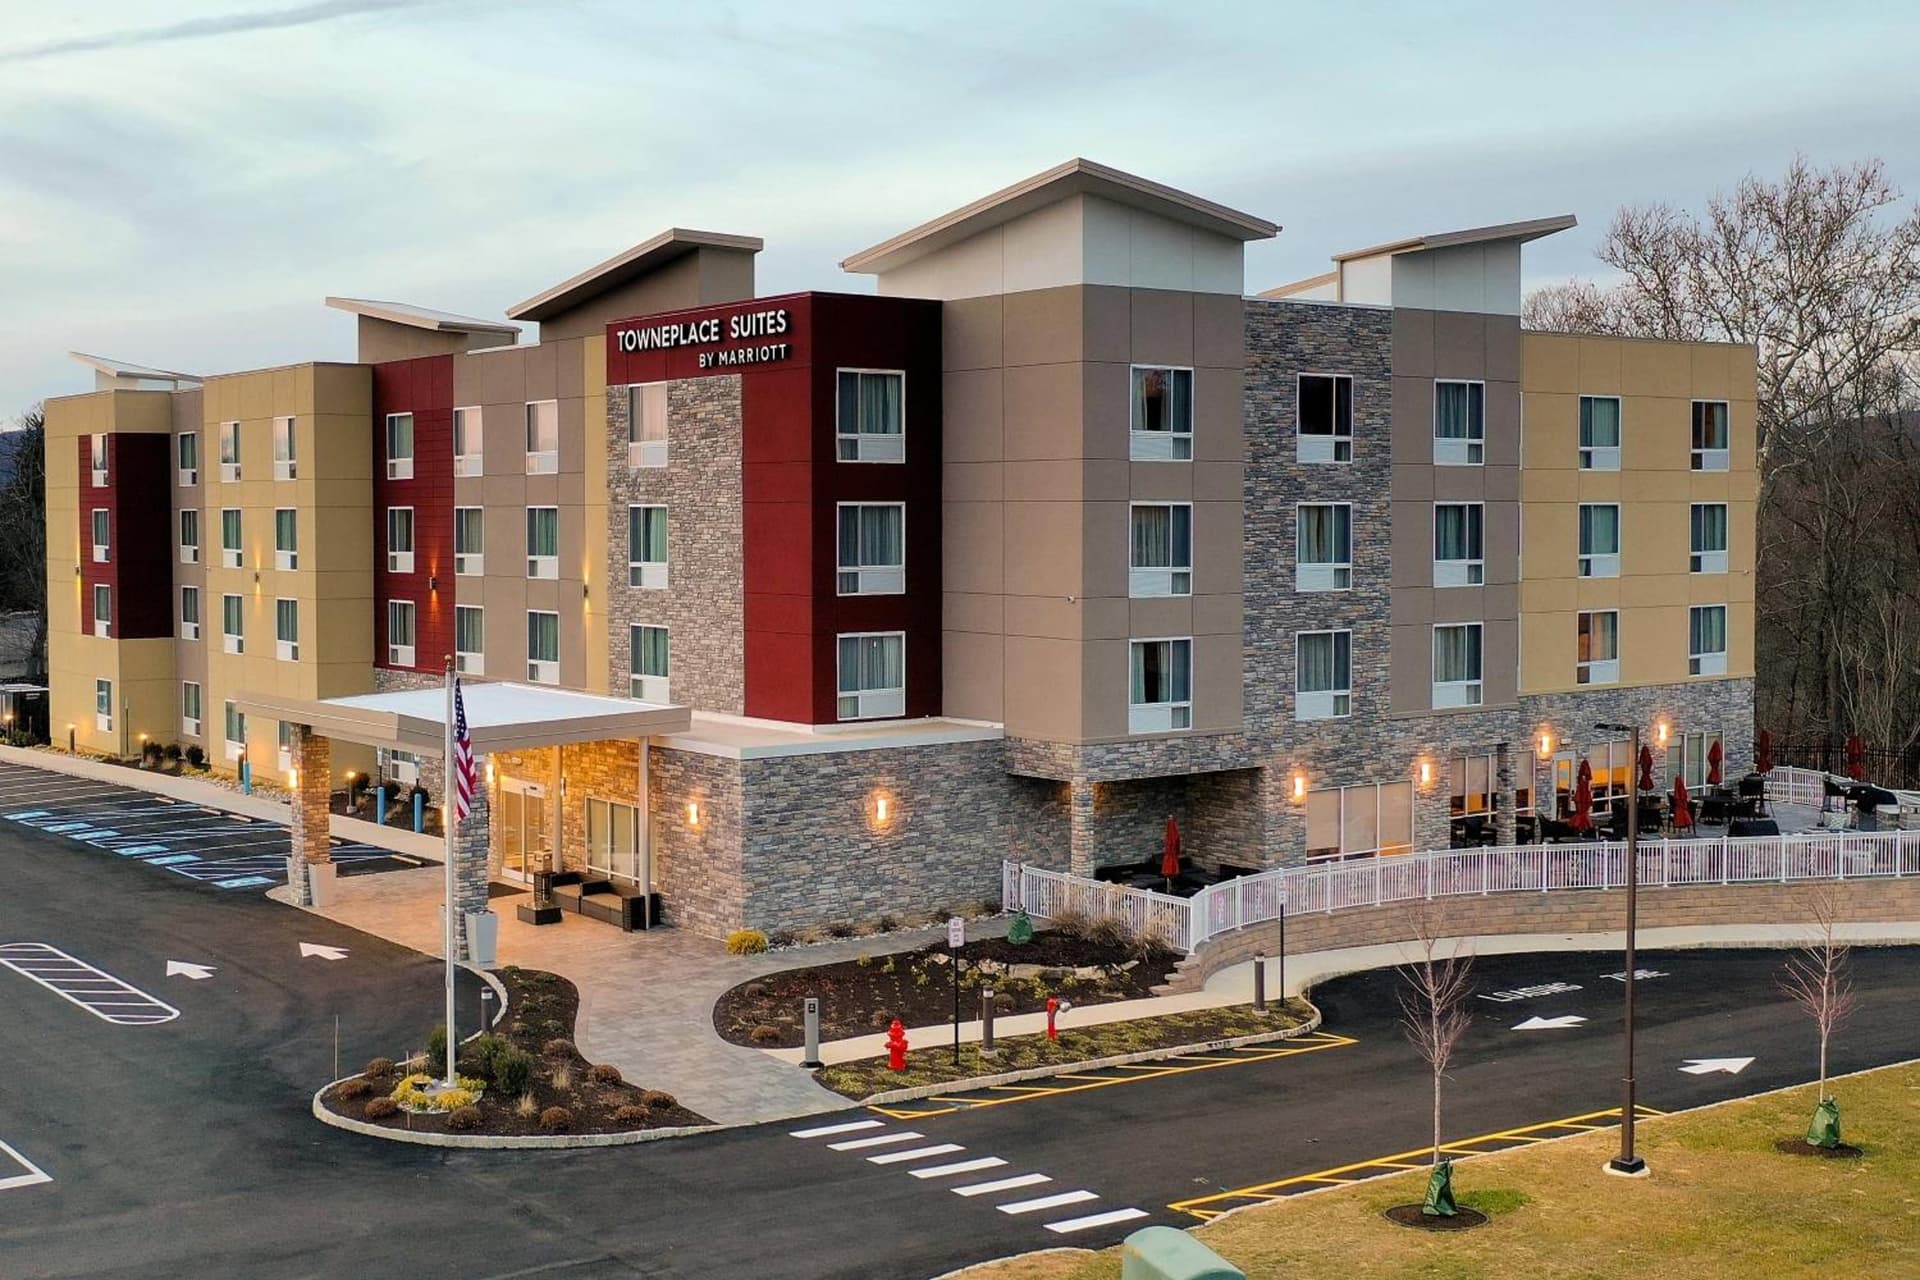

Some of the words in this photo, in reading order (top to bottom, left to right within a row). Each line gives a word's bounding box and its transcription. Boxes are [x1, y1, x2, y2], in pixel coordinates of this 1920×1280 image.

[617, 319, 720, 352] TOWNEPLACE
[730, 309, 787, 339] SUITES
[699, 353, 714, 368] BY
[719, 344, 787, 366] MARRIOTT
